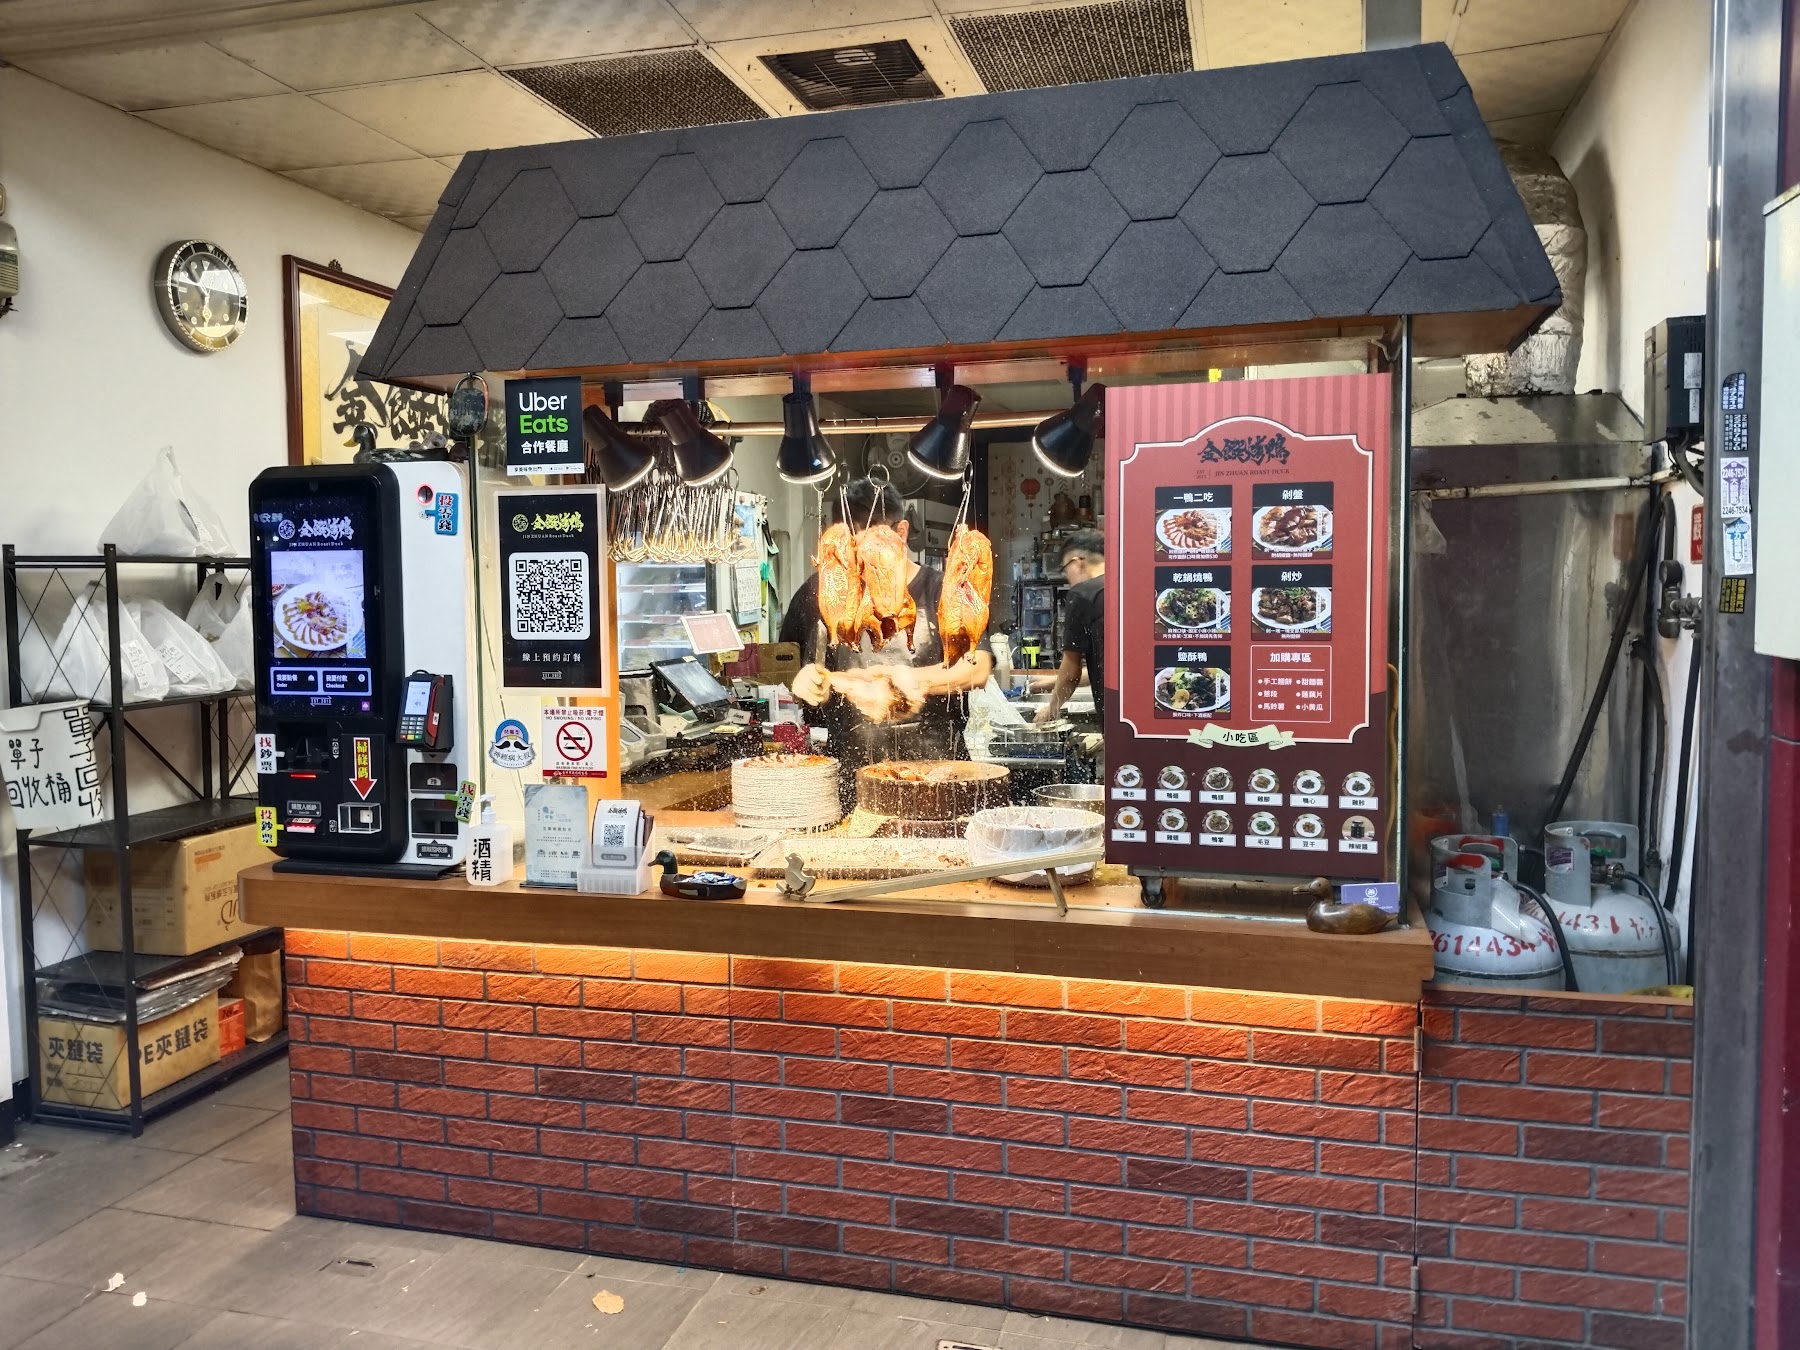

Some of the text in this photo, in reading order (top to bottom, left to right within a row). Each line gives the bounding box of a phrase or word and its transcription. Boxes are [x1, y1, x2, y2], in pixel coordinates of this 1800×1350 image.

[519, 392, 567, 412] Uber
[519, 414, 568, 434] Eats
[521, 440, 569, 454] 合作餐廳
[1173, 492, 1214, 503] 一鴨二吃
[1282, 489, 1303, 500] 剁盤
[1722, 506, 1748, 515] 2246-7534
[1173, 572, 1213, 583] 乾鍋燒鴨
[1281, 571, 1302, 582] 剁炒
[522, 652, 581, 663] 線上預約訂餐
[1177, 652, 1207, 663] 鹽酥鴨
[1270, 652, 1311, 663] 加購專區
[1263, 702, 1285, 710] 馬鈴薯
[1222, 731, 1259, 744] 小吃區
[8, 738, 44, 770] 單子
[259, 736, 272, 771] 找鈔票
[5, 772, 71, 808] 回收桶
[260, 809, 273, 844] 投鈔票
[471, 837, 492, 882] 酒精
[139, 1017, 208, 1065] E夾鏈袋
